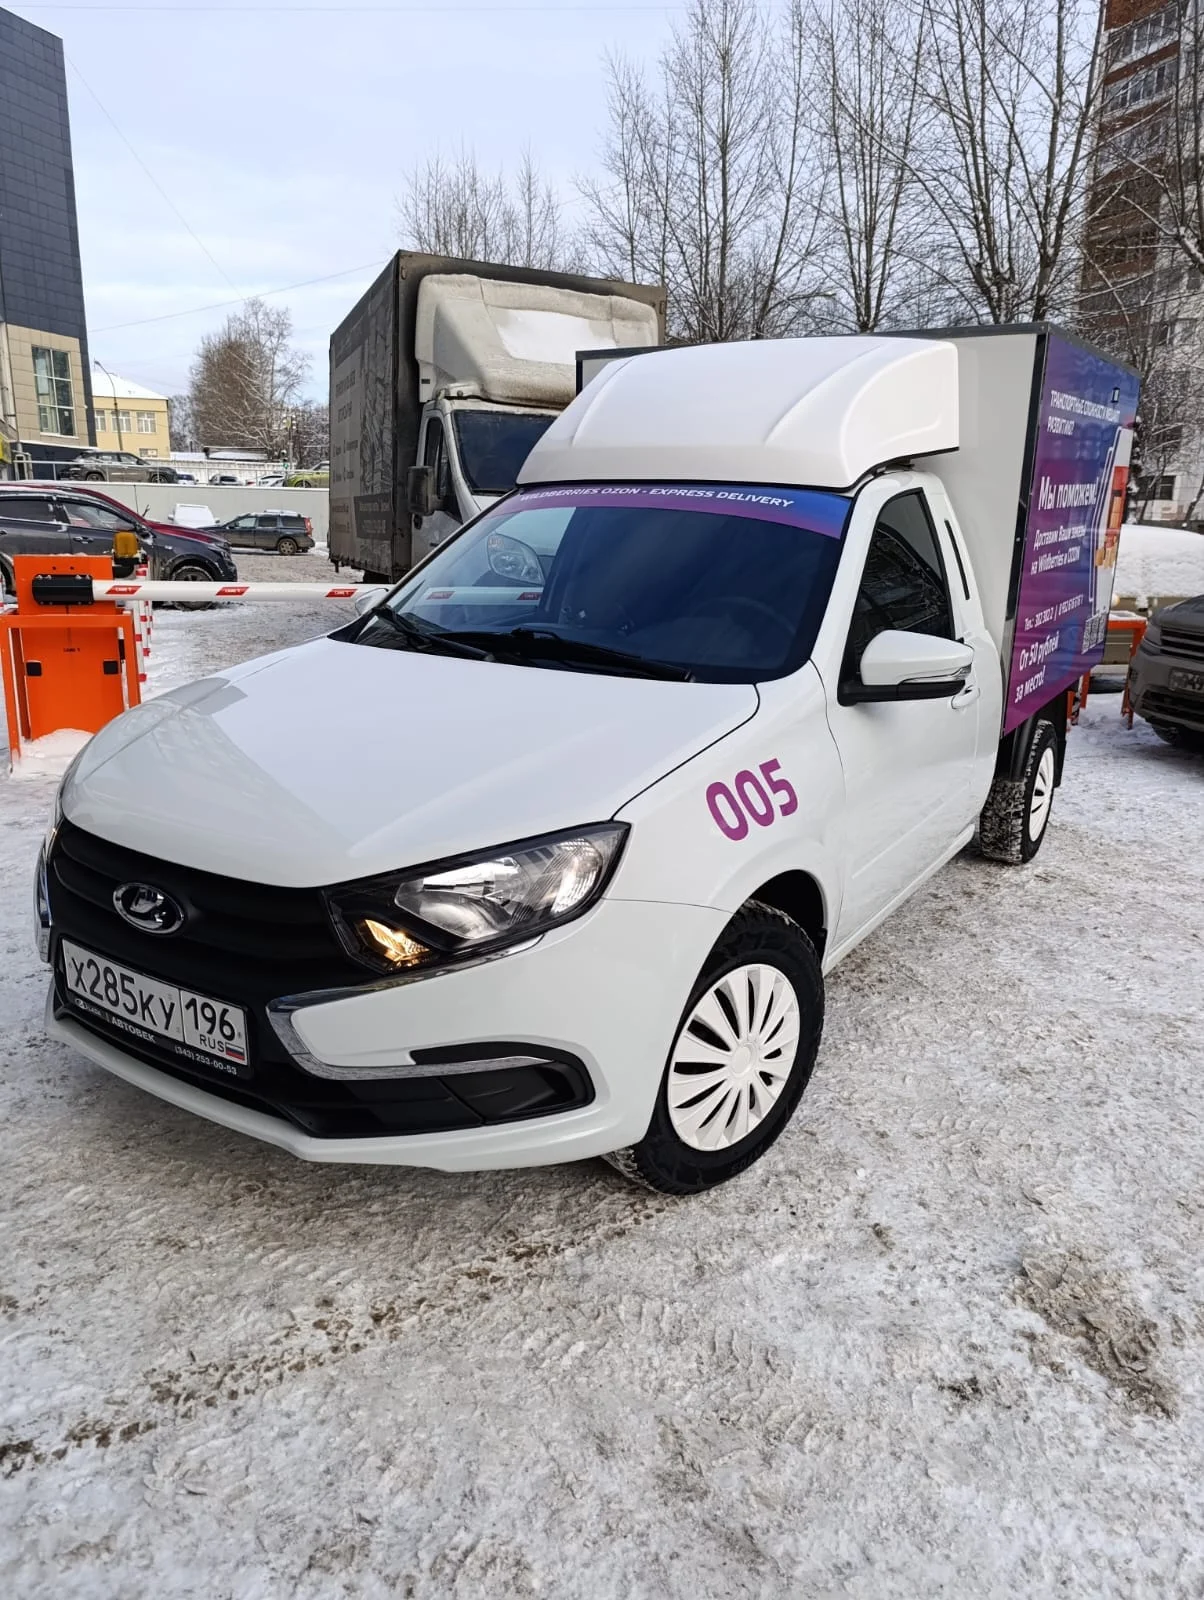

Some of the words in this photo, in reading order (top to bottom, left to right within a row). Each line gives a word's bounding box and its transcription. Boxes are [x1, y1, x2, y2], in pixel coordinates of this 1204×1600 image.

[519, 488, 599, 502] WILDBERRIES
[600, 487, 641, 495] OZON
[649, 488, 714, 498] EXPRESS
[716, 491, 795, 508] DELIVERY
[1038, 476, 1056, 510] Мы
[1019, 649, 1029, 672] От
[1037, 630, 1060, 665] рублей
[706, 758, 798, 841] 005
[185, 998, 236, 1041] 196
[199, 1034, 225, 1053] RUS
[175, 1046, 195, 1061] (343)
[195, 1054, 238, 1076] 253-00-53
